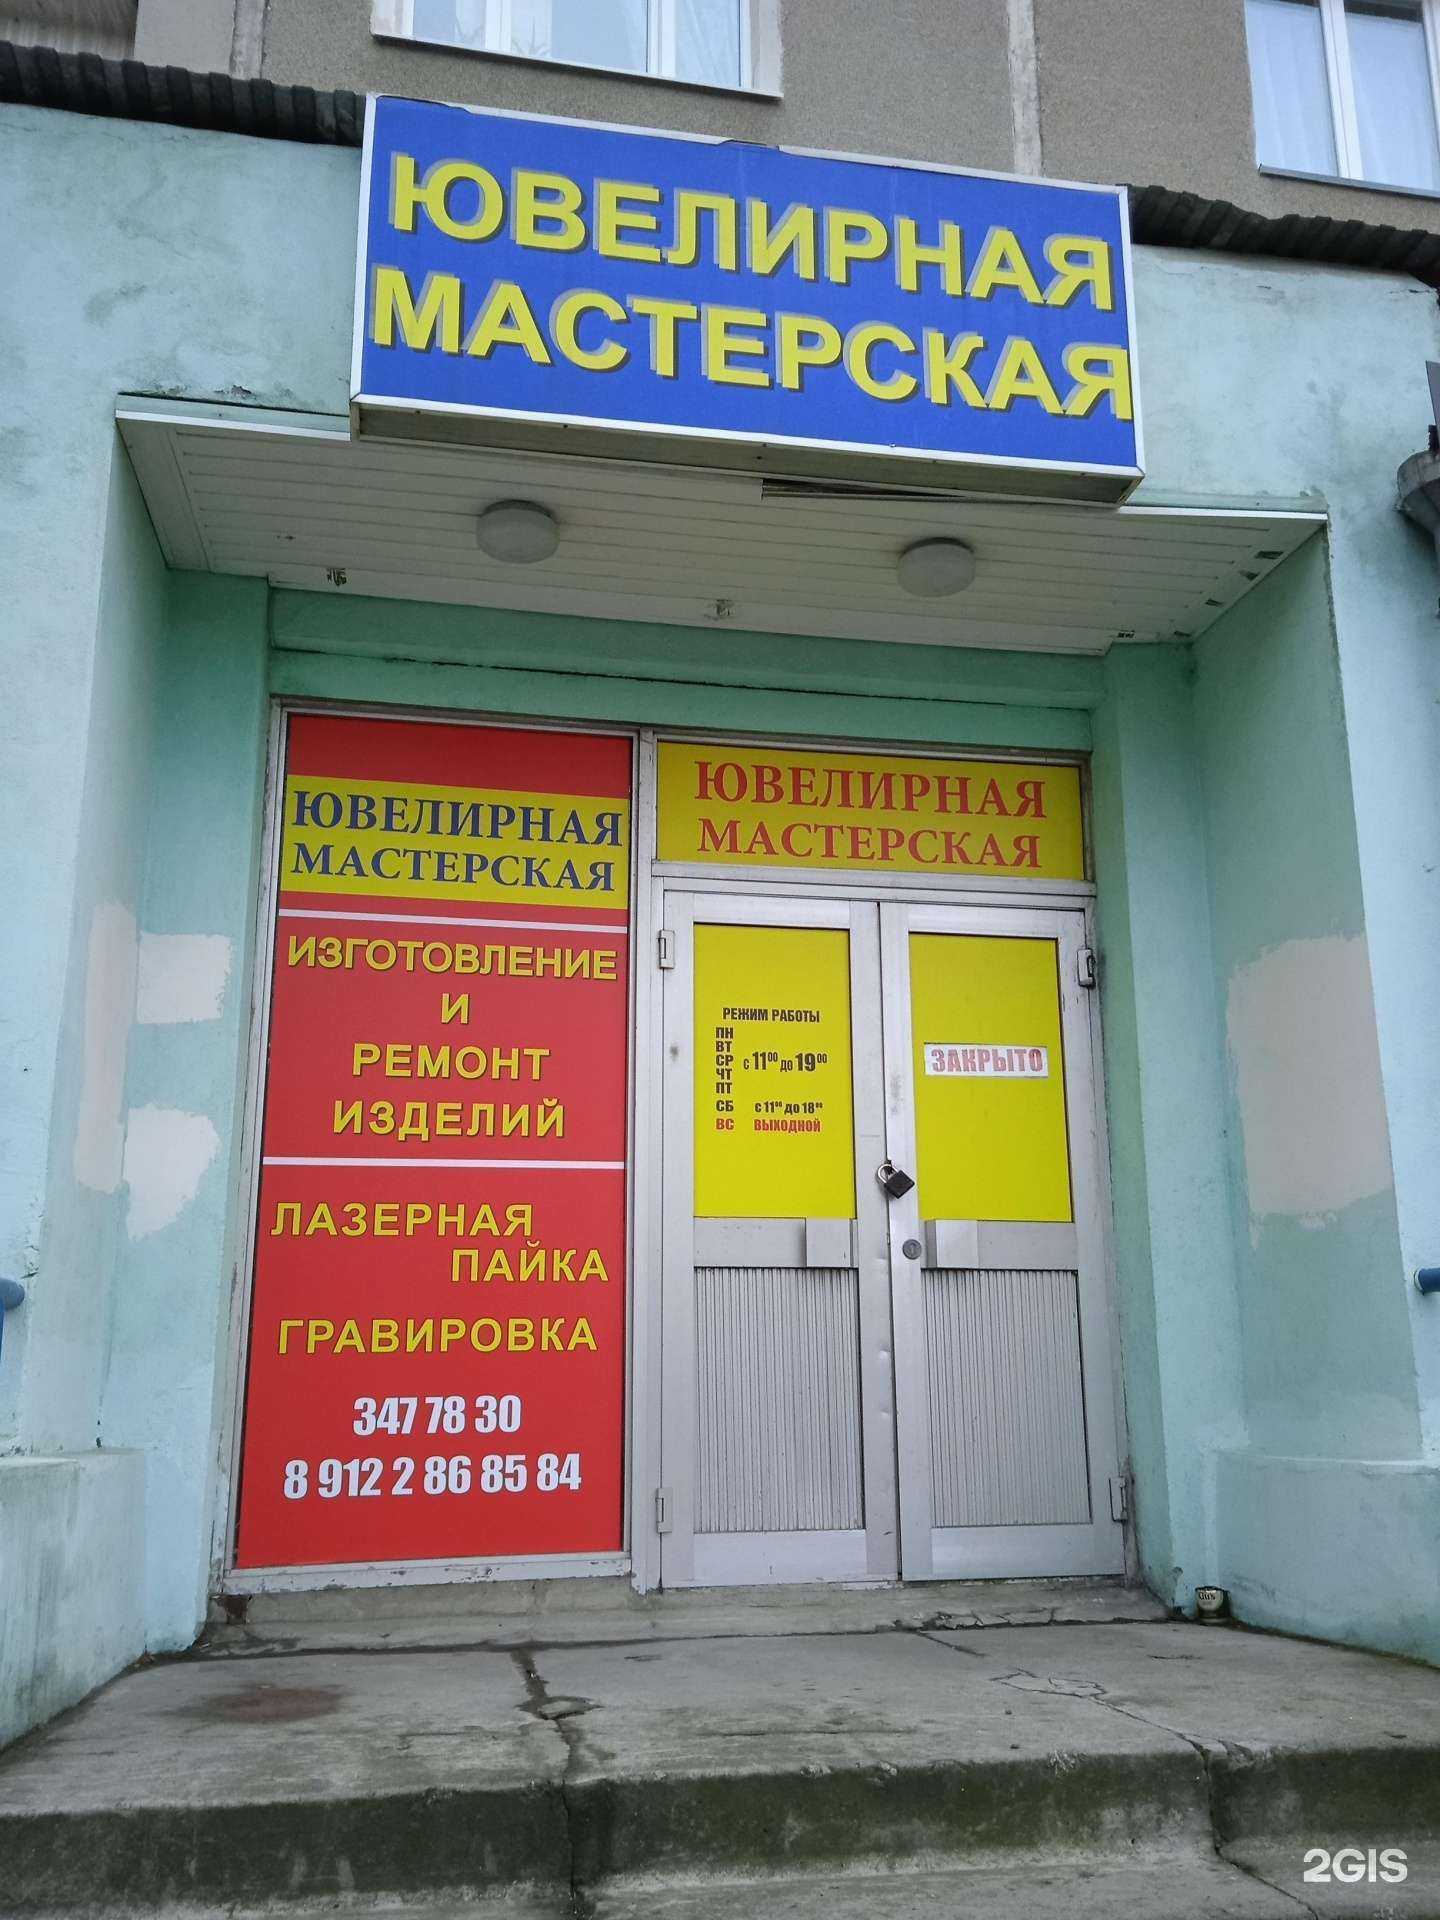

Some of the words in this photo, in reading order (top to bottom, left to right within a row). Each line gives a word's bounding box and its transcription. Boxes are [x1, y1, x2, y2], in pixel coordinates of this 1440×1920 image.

[389, 151, 1115, 312] ЮВЕЛИРНАЯ
[370, 265, 1133, 422] МАСТЕРСКАЯ
[694, 760, 1047, 818] ЮВЕЛИРНАЯ
[292, 790, 624, 847] ЮВЕЛИРНАЯ
[697, 818, 1042, 869] МАСТЕРСКАЯ
[290, 842, 616, 892] МАСТЕРСКАЯ
[287, 935, 619, 981] ИЗГОТОВЛЕНИЕ
[440, 993, 470, 1025] И
[722, 1007, 768, 1021] РЕЖИМ
[772, 1009, 820, 1023] РАБОТЫ
[715, 1026, 734, 1039] ПН
[715, 1040, 732, 1052] ВТ
[352, 1043, 551, 1080] РЕМОНТ
[715, 1054, 734, 1066] СР
[715, 1068, 732, 1080] ЧТ
[780, 1060, 793, 1072] до
[931, 1047, 1043, 1073] ЗАКРЫТО
[715, 1082, 733, 1094] ПТ
[332, 1098, 565, 1141] ИЗДЕЛИЙ
[716, 1099, 734, 1112] СБ
[784, 1103, 800, 1115] до
[716, 1118, 734, 1131] ВС
[754, 1118, 821, 1133] ВЫХОДНОЙ
[270, 1202, 534, 1237] ЛАЗЕРНАЯ
[450, 1240, 609, 1282] ПАЙКА
[278, 1317, 599, 1355] ГРАВИРОВКА
[353, 1397, 418, 1436] 347
[425, 1395, 466, 1435] 78
[475, 1394, 522, 1434] 30
[283, 1459, 309, 1500] 8
[317, 1458, 384, 1498] 912
[391, 1456, 414, 1496] 2
[423, 1455, 472, 1495] 86
[480, 1454, 529, 1494] 85
[536, 1452, 582, 1491] 84
